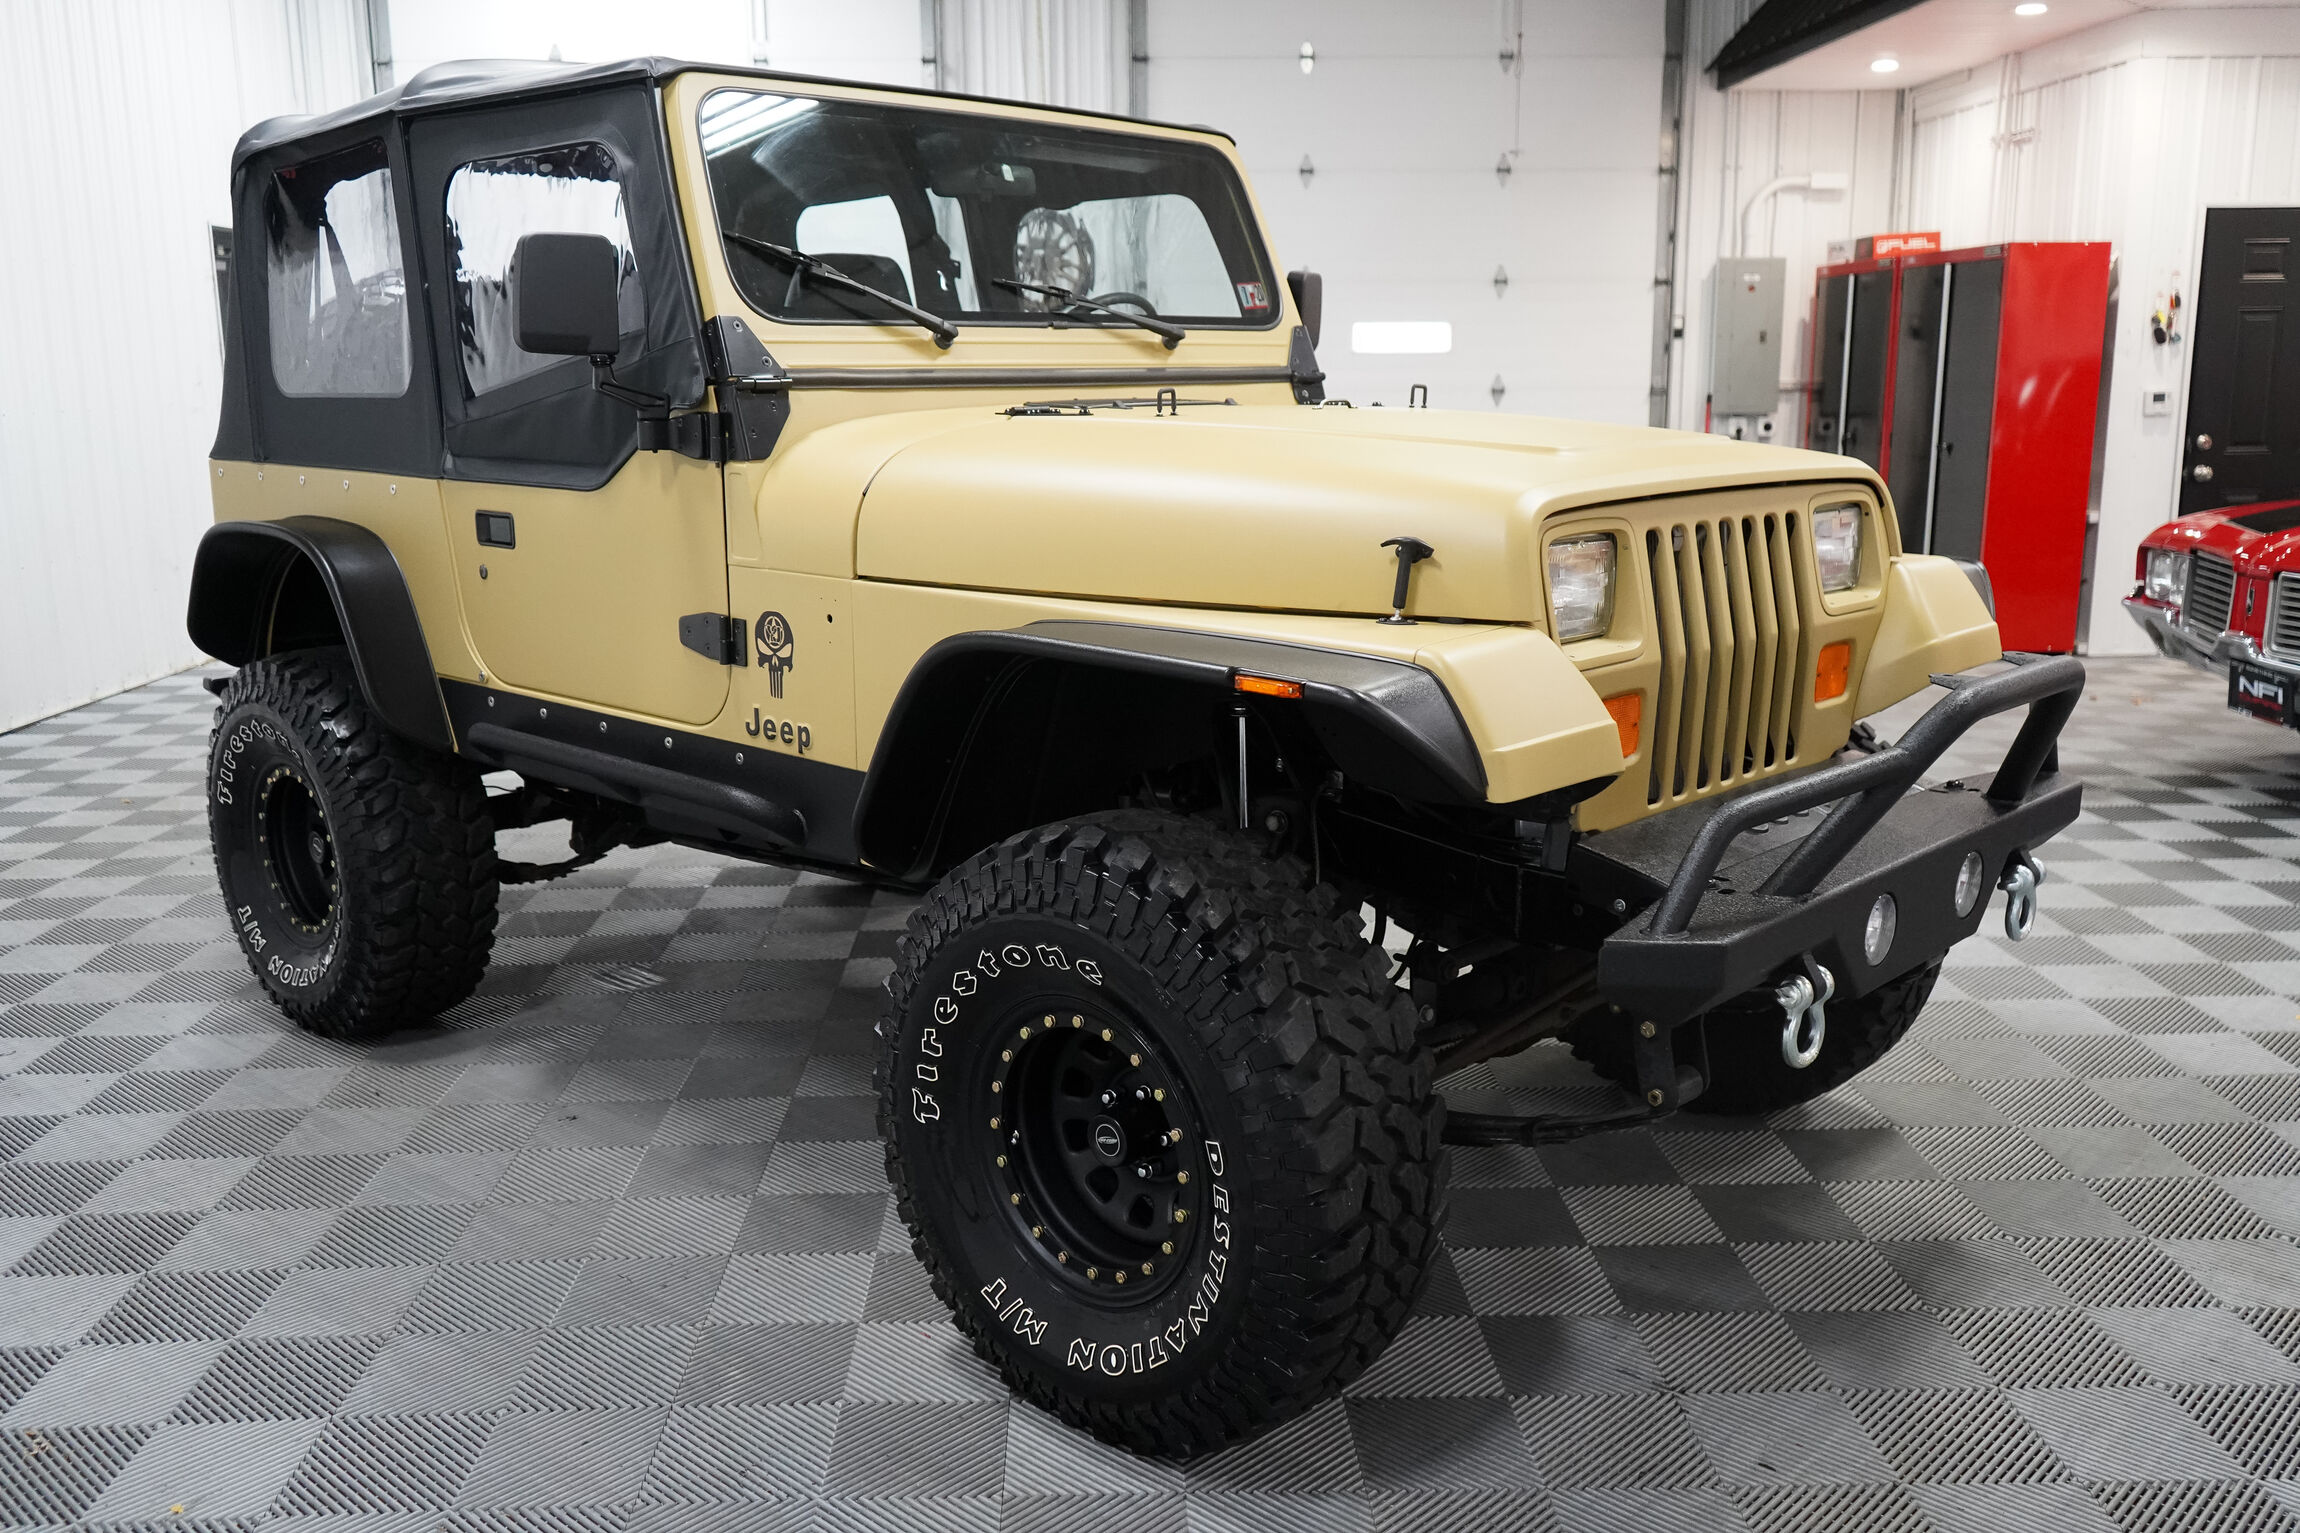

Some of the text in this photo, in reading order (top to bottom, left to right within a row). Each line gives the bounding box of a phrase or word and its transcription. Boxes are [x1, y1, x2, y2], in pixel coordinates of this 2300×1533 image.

[1888, 237, 1936, 251] FUEL
[2239, 675, 2284, 705] NFI
[745, 707, 811, 754] Jeep
[912, 944, 1104, 1124] Firestone
[1067, 1140, 1232, 1376] DESTINATION
